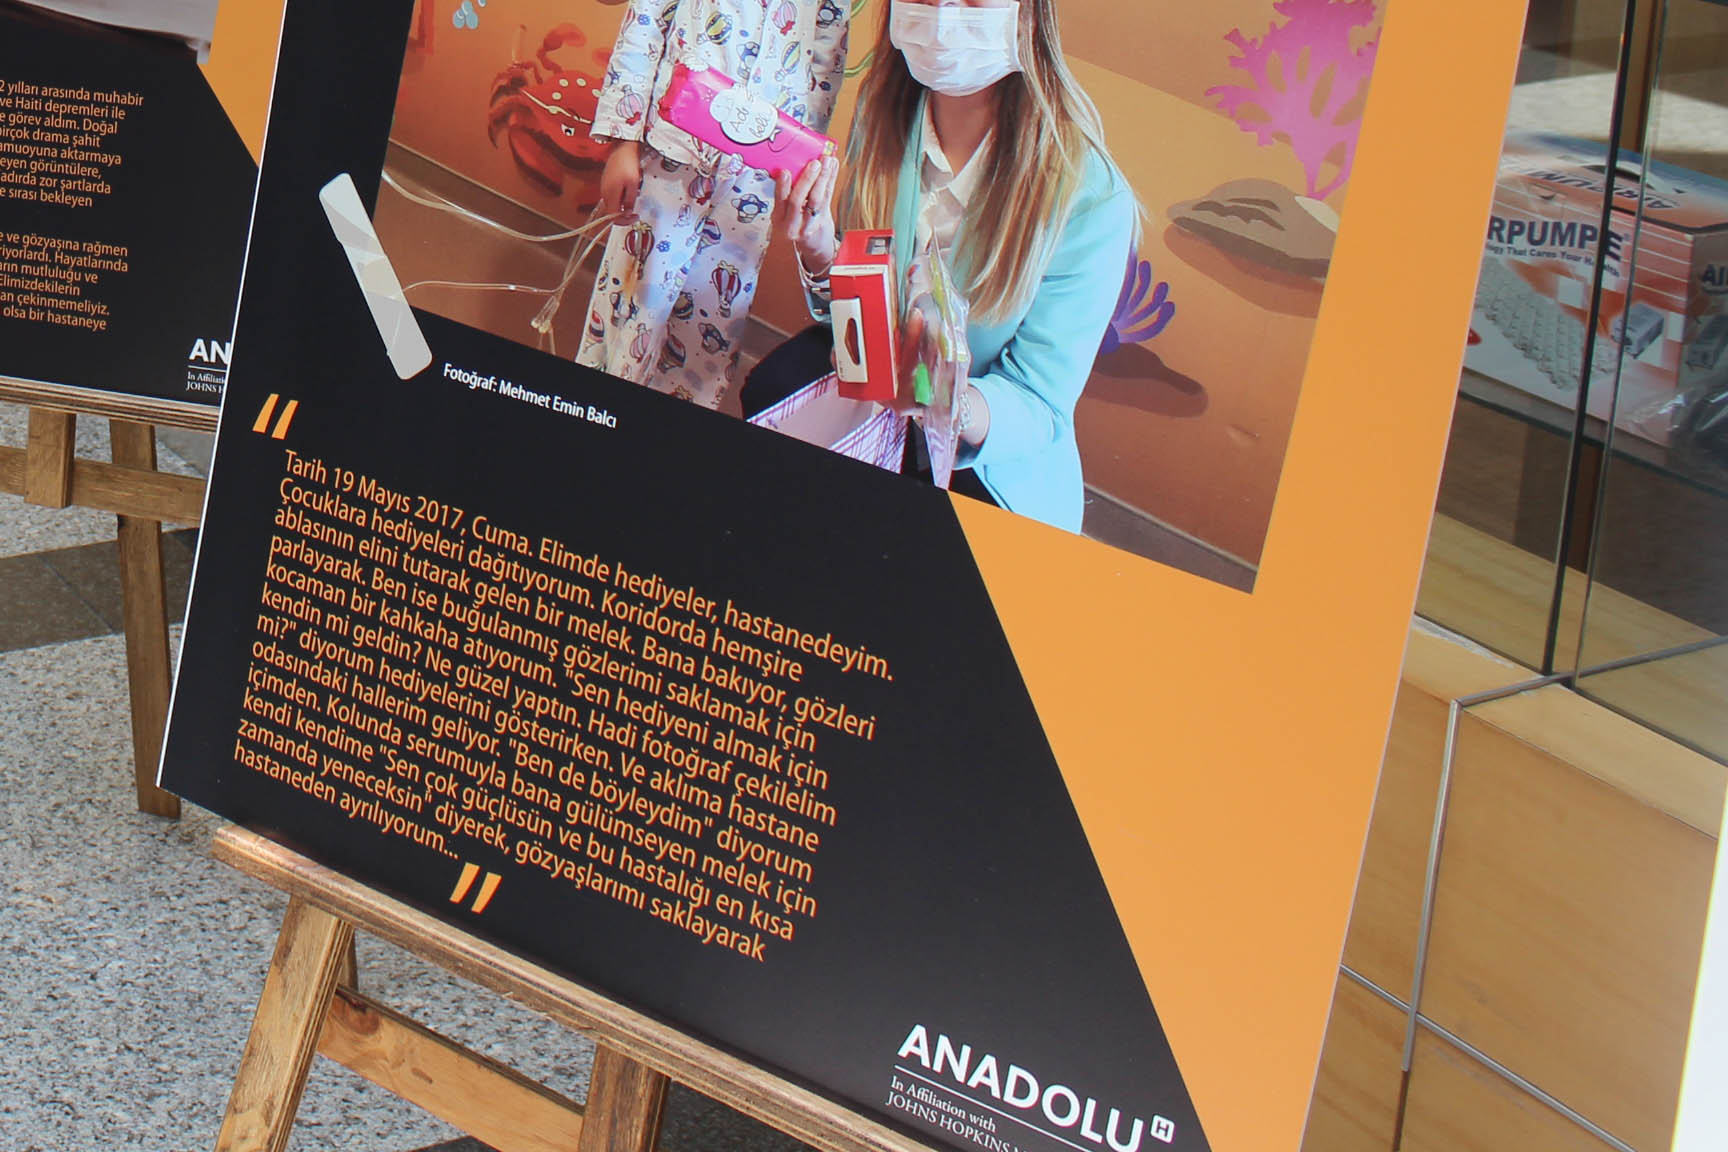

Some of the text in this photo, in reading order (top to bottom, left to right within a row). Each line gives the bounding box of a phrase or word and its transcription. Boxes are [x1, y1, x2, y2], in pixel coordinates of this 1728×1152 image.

[8, 188, 37, 200] sırası
[39, 188, 92, 208] bekleyen
[60, 146, 122, 167] aktarmaya
[189, 338, 231, 365] AN
[443, 363, 617, 429] Fotoğraf: Mehmet Emin Balcı
[279, 477, 803, 682] Çocuklara hediyeleri dağıtıyorum. Koridorda hemşire
[285, 448, 893, 681] Tarih 19 Mayıs 2017, Cuma. Elimde hediyeler, hastanedeyim.
[269, 535, 816, 752] parlayarak. Ben ise buğulanmış gözlerimi saklamak için
[234, 740, 459, 860] hastaneden ayrılıyorum...
[237, 718, 318, 767] zamanda
[435, 800, 510, 855] diyerek,
[515, 840, 646, 910] gözyaşlarımı
[649, 897, 765, 962] saklayarak
[885, 1091, 937, 1124] JOHNS
[939, 1117, 1010, 1152] HOPKINS
[891, 1075, 996, 1133] In Affiliation with
[897, 1024, 1144, 1152] ANADOLU
